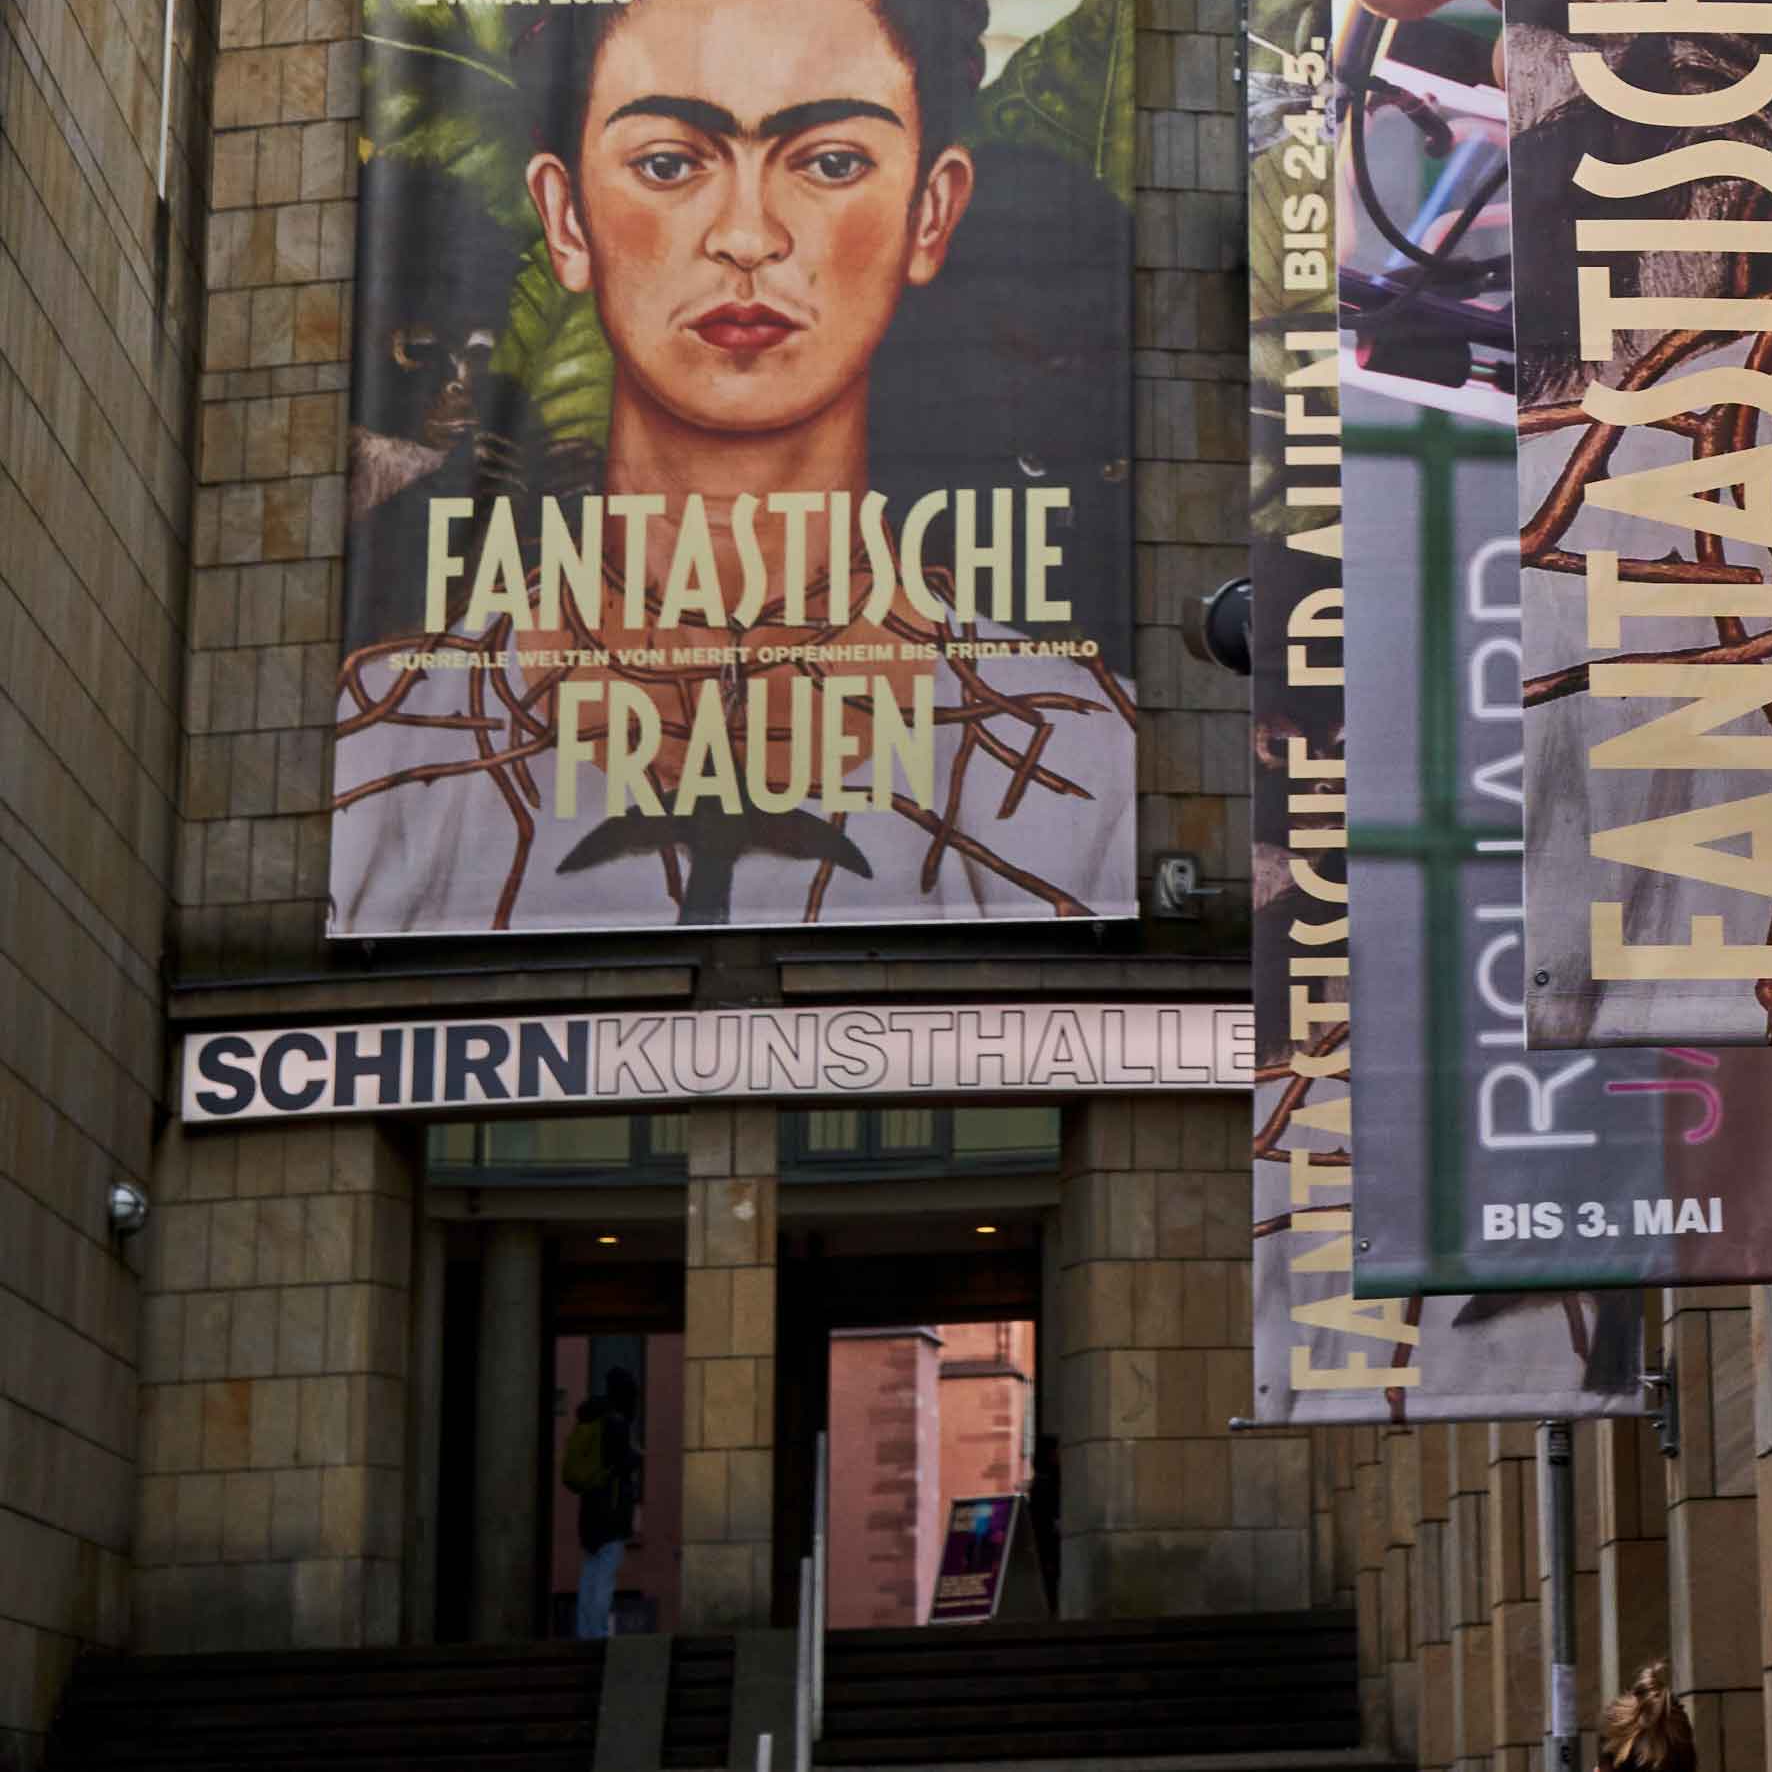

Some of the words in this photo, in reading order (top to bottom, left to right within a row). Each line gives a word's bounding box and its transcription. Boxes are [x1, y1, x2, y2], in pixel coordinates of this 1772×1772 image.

[1283, 193, 1328, 290] BIS
[424, 486, 1073, 635] FANTASTISCHE
[389, 649, 510, 671] SURREALE
[518, 648, 610, 668] WELTEN
[616, 648, 666, 667] VON
[672, 646, 752, 665] MERET
[758, 643, 894, 664] OPPENHEIM
[902, 642, 938, 660] BIS
[945, 642, 1011, 659] FRIDA
[1019, 640, 1099, 658] KAHLO
[554, 674, 935, 819] FRAUEN
[1482, 1201, 1564, 1241] BIS
[1577, 1201, 1620, 1238] 3.
[1632, 1197, 1724, 1236] MAI
